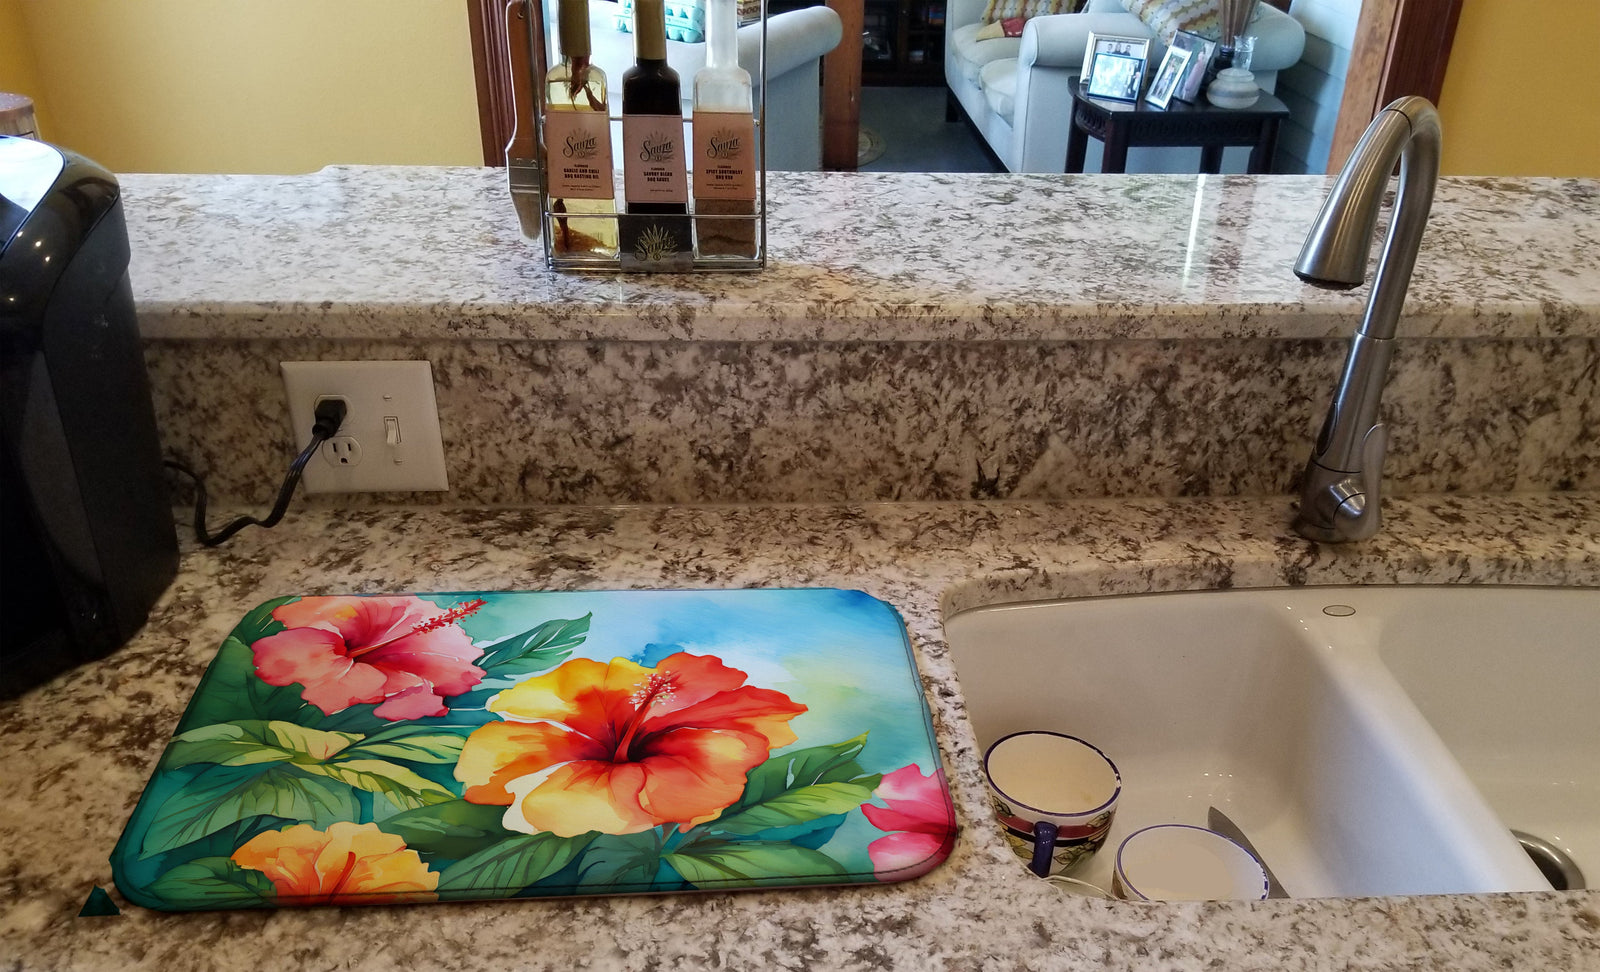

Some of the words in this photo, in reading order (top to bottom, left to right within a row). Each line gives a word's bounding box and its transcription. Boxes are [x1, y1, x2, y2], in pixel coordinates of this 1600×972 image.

[563, 136, 597, 158] Sauza
[640, 140, 673, 162] Sauza
[707, 137, 739, 158] Sauza
